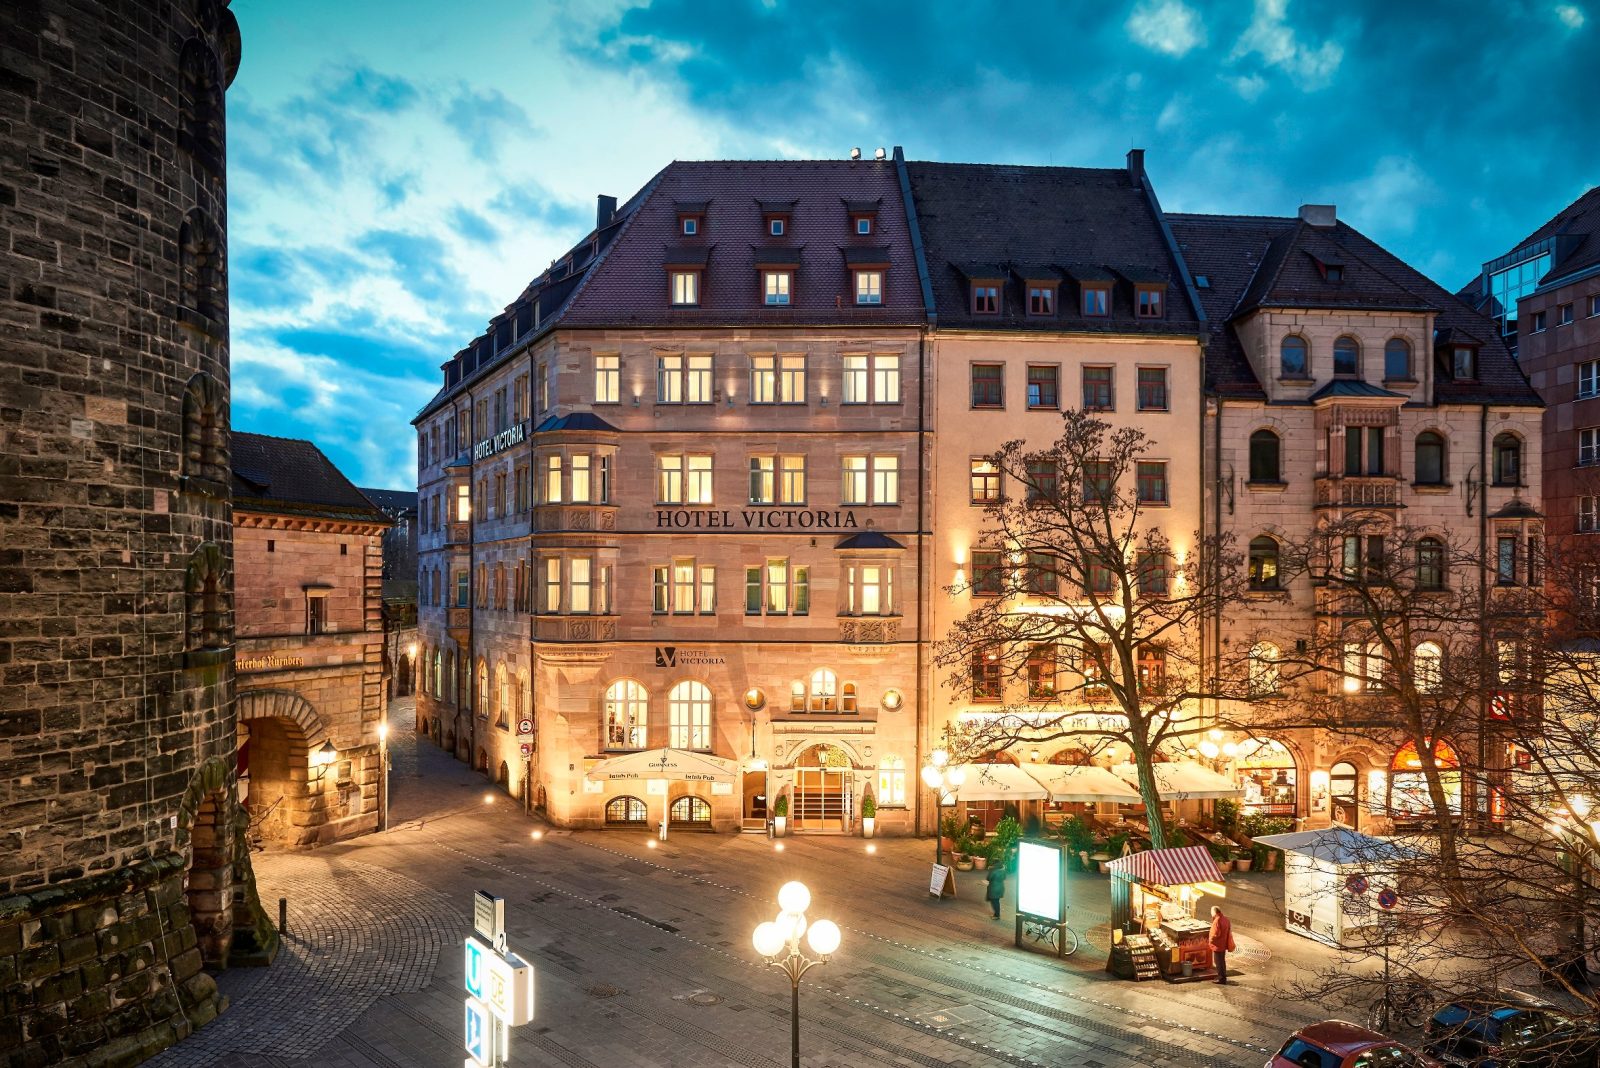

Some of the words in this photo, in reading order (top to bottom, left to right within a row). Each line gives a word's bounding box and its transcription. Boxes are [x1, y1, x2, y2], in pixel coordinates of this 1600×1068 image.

[474, 439, 493, 461] HOTEL
[493, 423, 524, 454] VICTORIA
[656, 510, 735, 528] HOTEL
[741, 510, 859, 528] VICTORIA
[680, 657, 725, 665] VICTORIA
